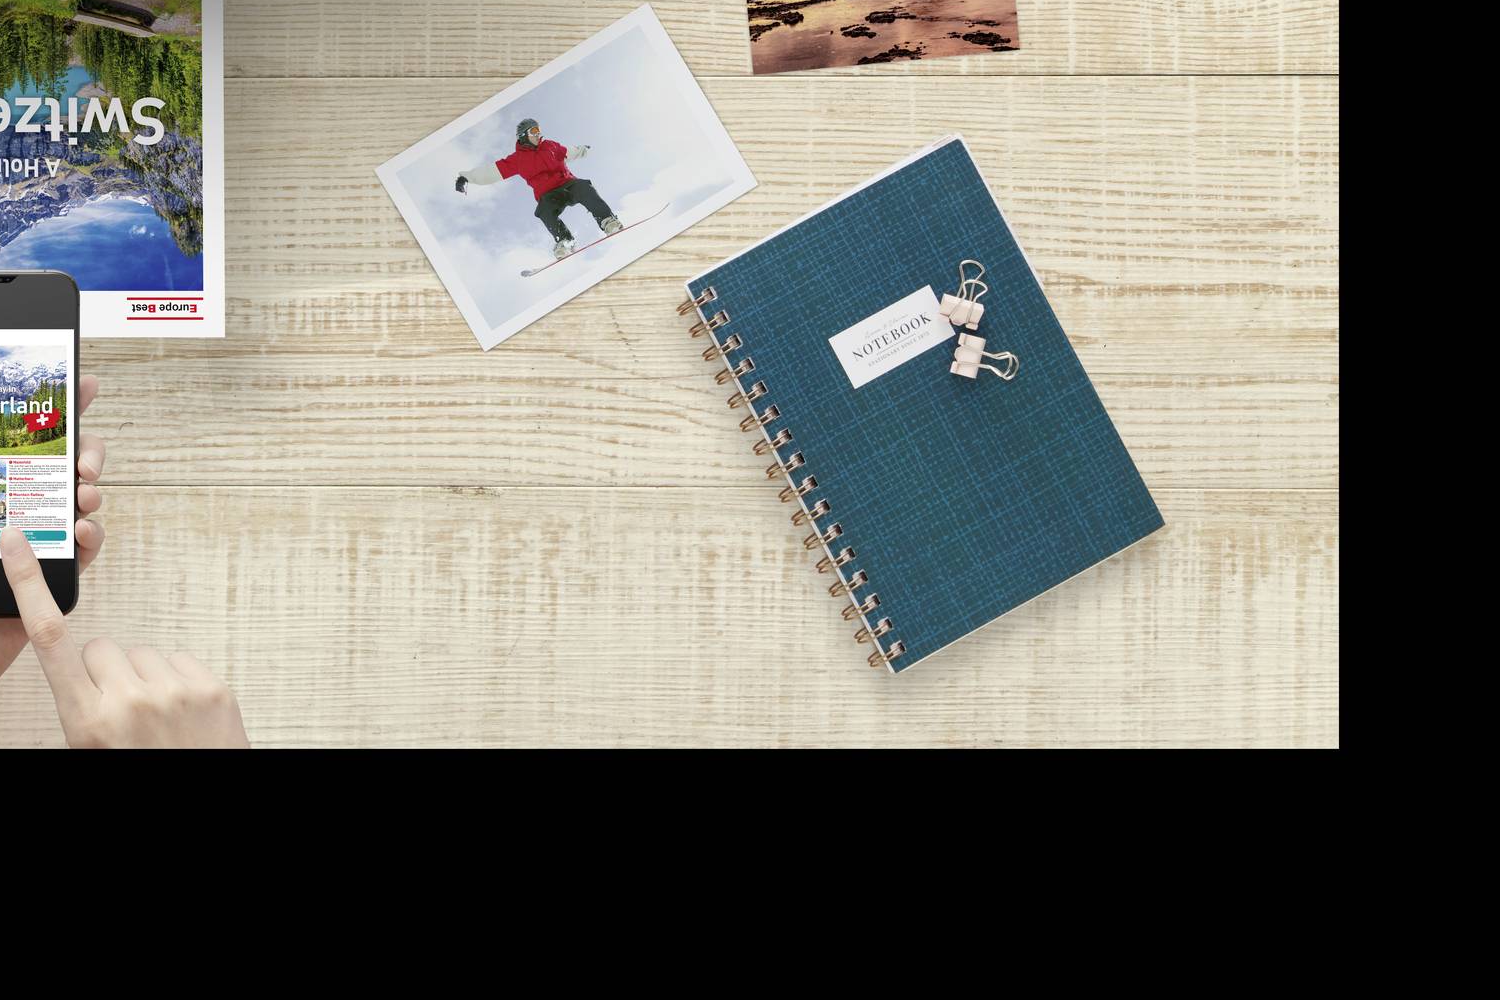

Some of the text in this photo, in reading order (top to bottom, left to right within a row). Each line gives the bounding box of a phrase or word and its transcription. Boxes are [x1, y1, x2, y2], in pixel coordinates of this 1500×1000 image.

[46, 158, 61, 177] A
[132, 303, 198, 313] Europe Best
[852, 312, 932, 360] NOTEBOOK
